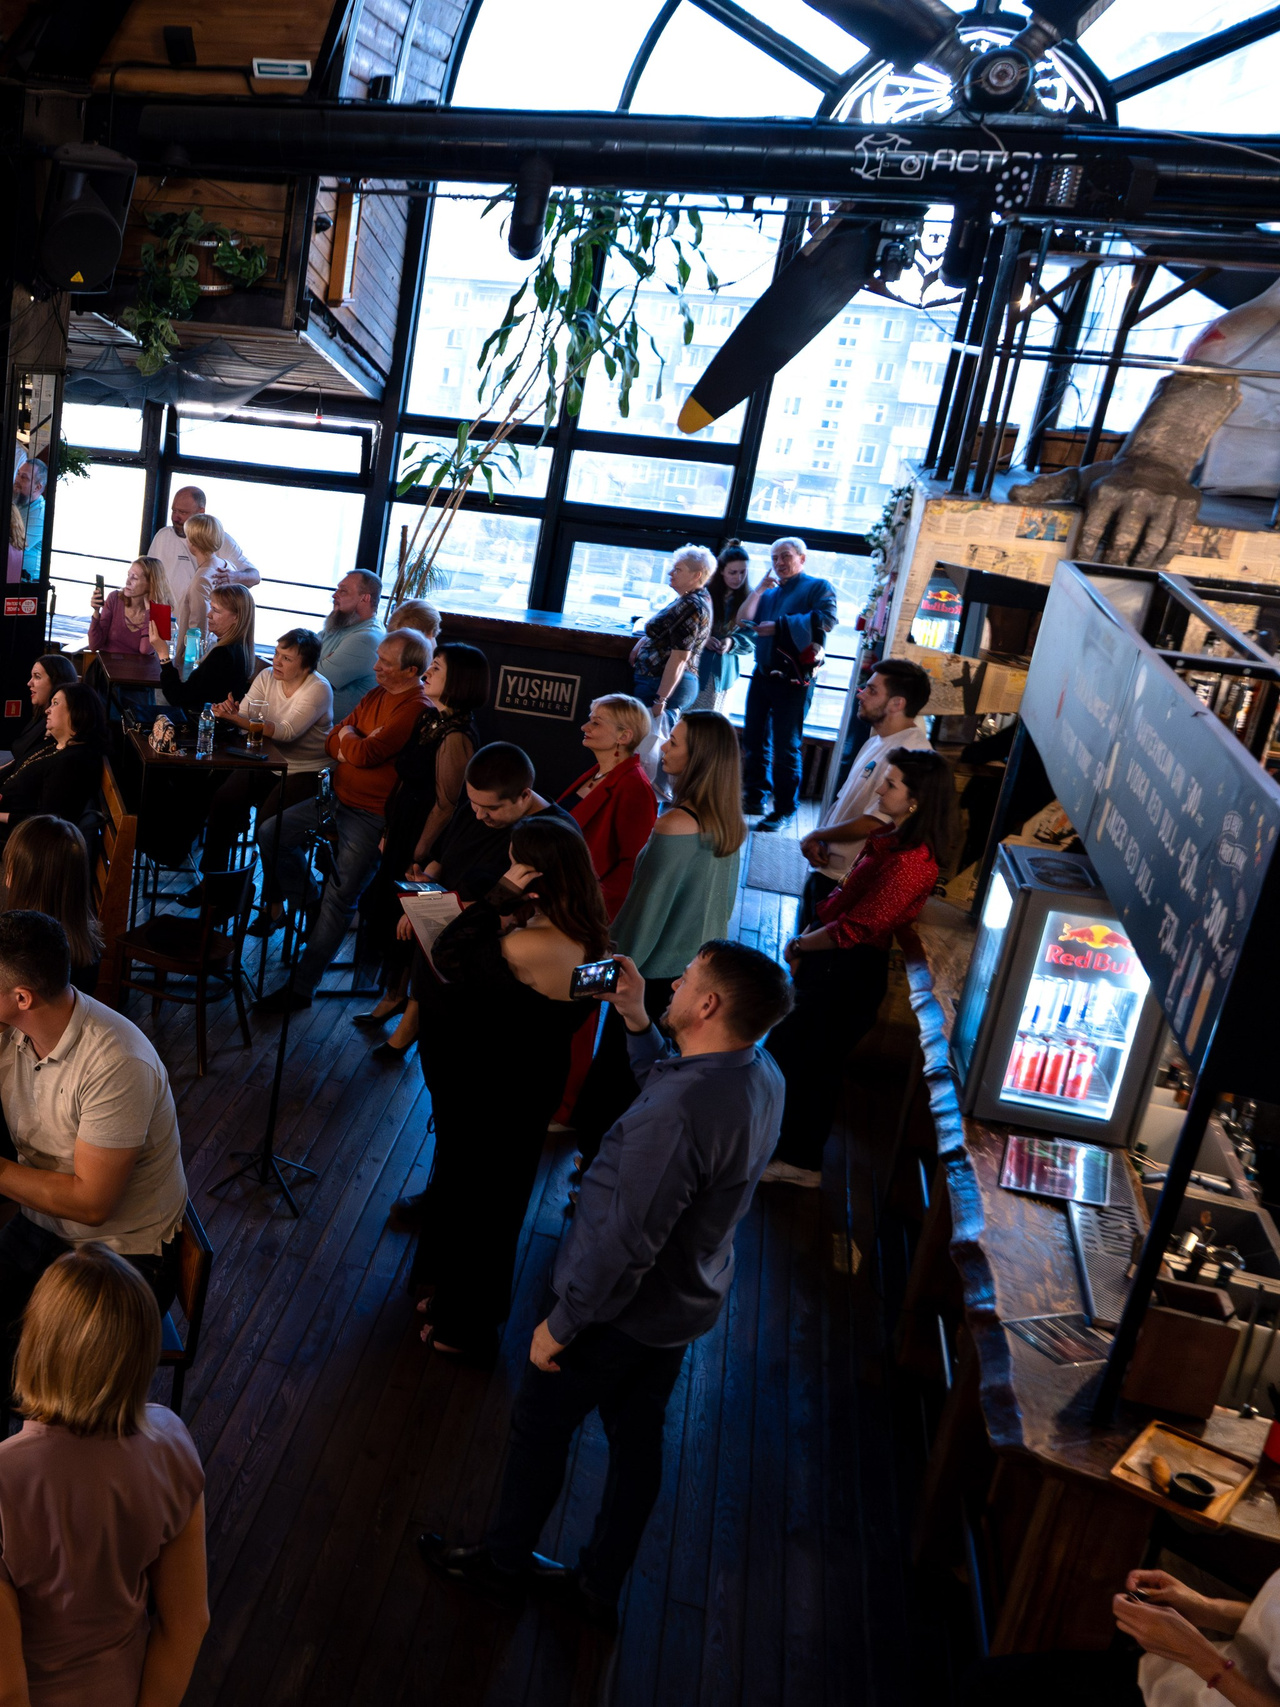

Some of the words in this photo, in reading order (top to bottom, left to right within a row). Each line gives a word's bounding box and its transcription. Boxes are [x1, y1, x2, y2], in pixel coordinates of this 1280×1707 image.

[506, 674, 572, 703] YUSHIN
[505, 696, 569, 712] BROTHERS
[1045, 944, 1093, 969] Red
[1092, 952, 1138, 976] Bull
